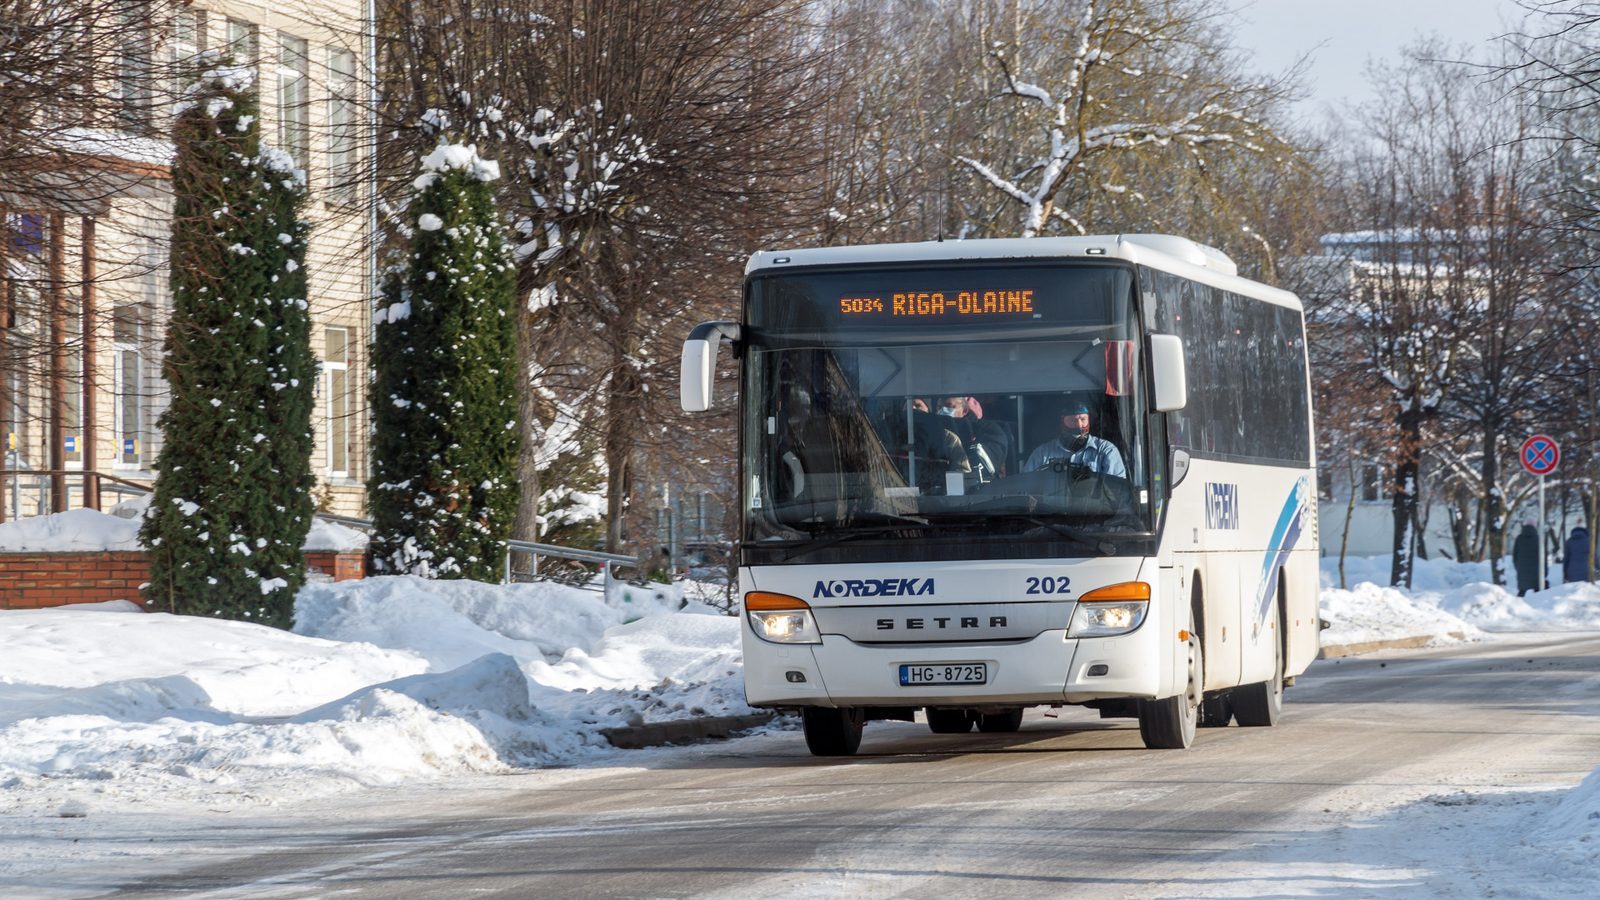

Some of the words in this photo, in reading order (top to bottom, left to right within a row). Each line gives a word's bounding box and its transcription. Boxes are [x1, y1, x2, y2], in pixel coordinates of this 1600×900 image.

[840, 298, 884, 313] 5034
[893, 290, 1033, 315] RIGA-OLAINE
[1205, 482, 1239, 530] NORDEKA
[813, 578, 935, 598] NORDEKA
[1026, 576, 1071, 594] 202
[877, 616, 1008, 630] SETRA
